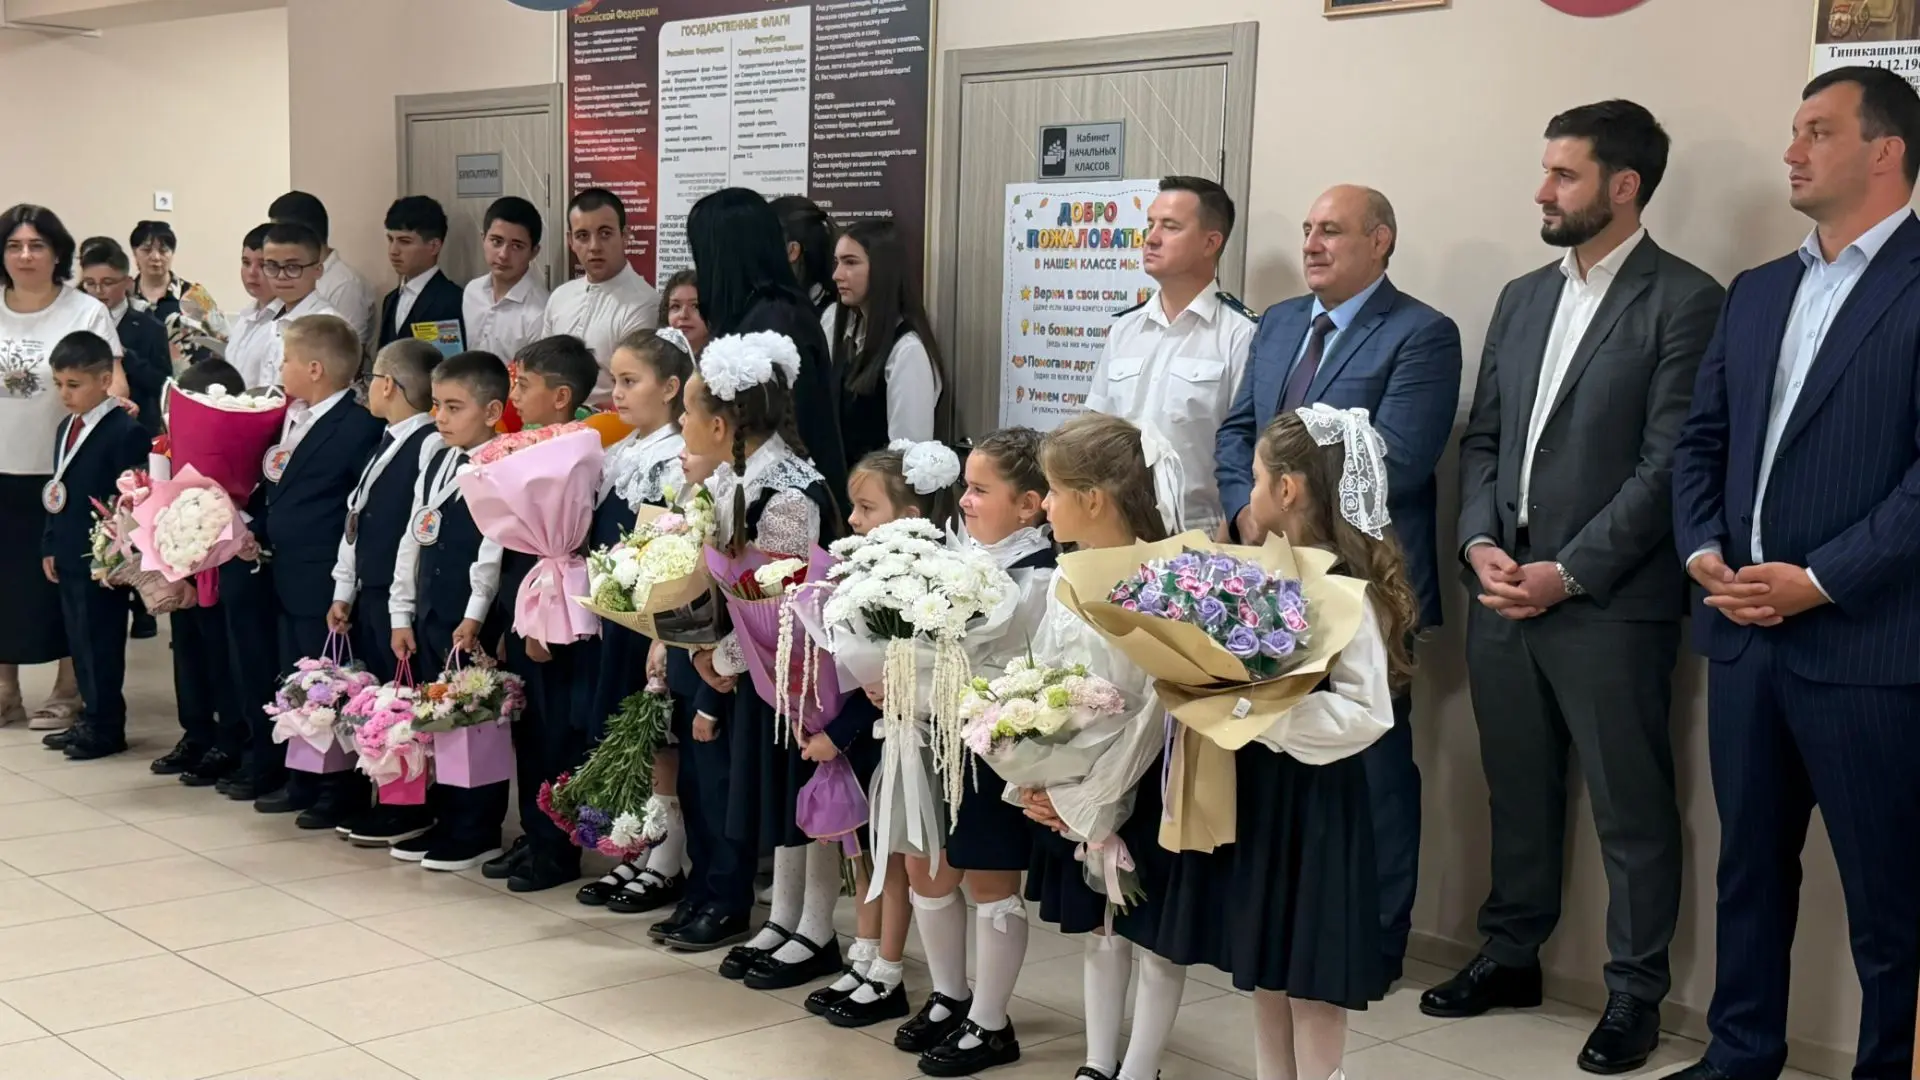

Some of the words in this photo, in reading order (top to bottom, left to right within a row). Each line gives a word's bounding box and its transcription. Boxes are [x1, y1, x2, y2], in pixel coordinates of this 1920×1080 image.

[616, 8, 658, 20] Федерации
[681, 18, 758, 36] ГОСУДАРСТВЕННЫЕ
[761, 14, 791, 28] ФЛАГИ
[1077, 133, 1110, 142] Кабинет
[1070, 147, 1116, 156] НАЧАЛЬНЫХ
[1075, 161, 1110, 171] КЛАССОВ
[1058, 201, 1117, 226] ДОБРО
[1035, 258, 1040, 269] В
[1043, 258, 1077, 269] НАШЕМ
[1080, 258, 1116, 270] КЛАССЕ
[1120, 258, 1140, 270] МЫ:
[1034, 286, 1065, 301] Верим
[1067, 290, 1074, 299] в
[1076, 290, 1099, 300] свои
[1102, 290, 1128, 301] силы
[1033, 323, 1045, 335] Не
[1048, 323, 1084, 336] боимся
[1028, 355, 1071, 369] Помогаем
[1074, 361, 1095, 373] друг
[1028, 388, 1059, 403] Умеем
